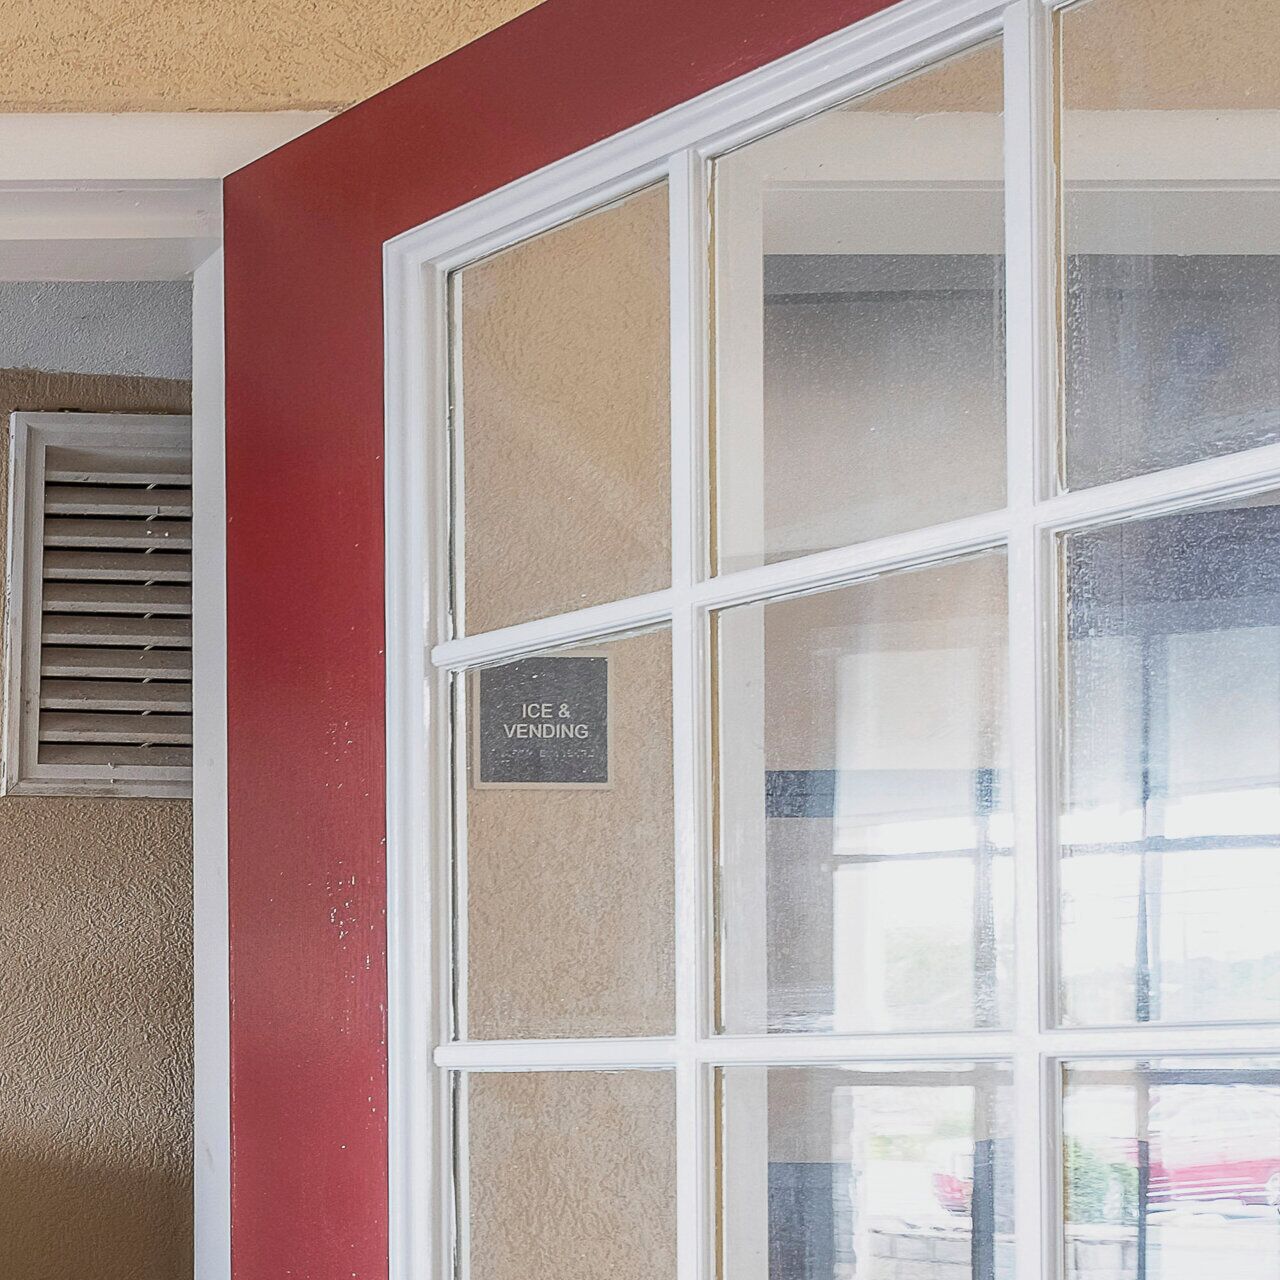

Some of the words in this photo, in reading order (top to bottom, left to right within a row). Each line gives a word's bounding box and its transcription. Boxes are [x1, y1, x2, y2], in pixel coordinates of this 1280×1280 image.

[522, 703, 553, 718] ICE
[558, 703, 571, 718] &
[503, 723, 589, 739] VENDING
